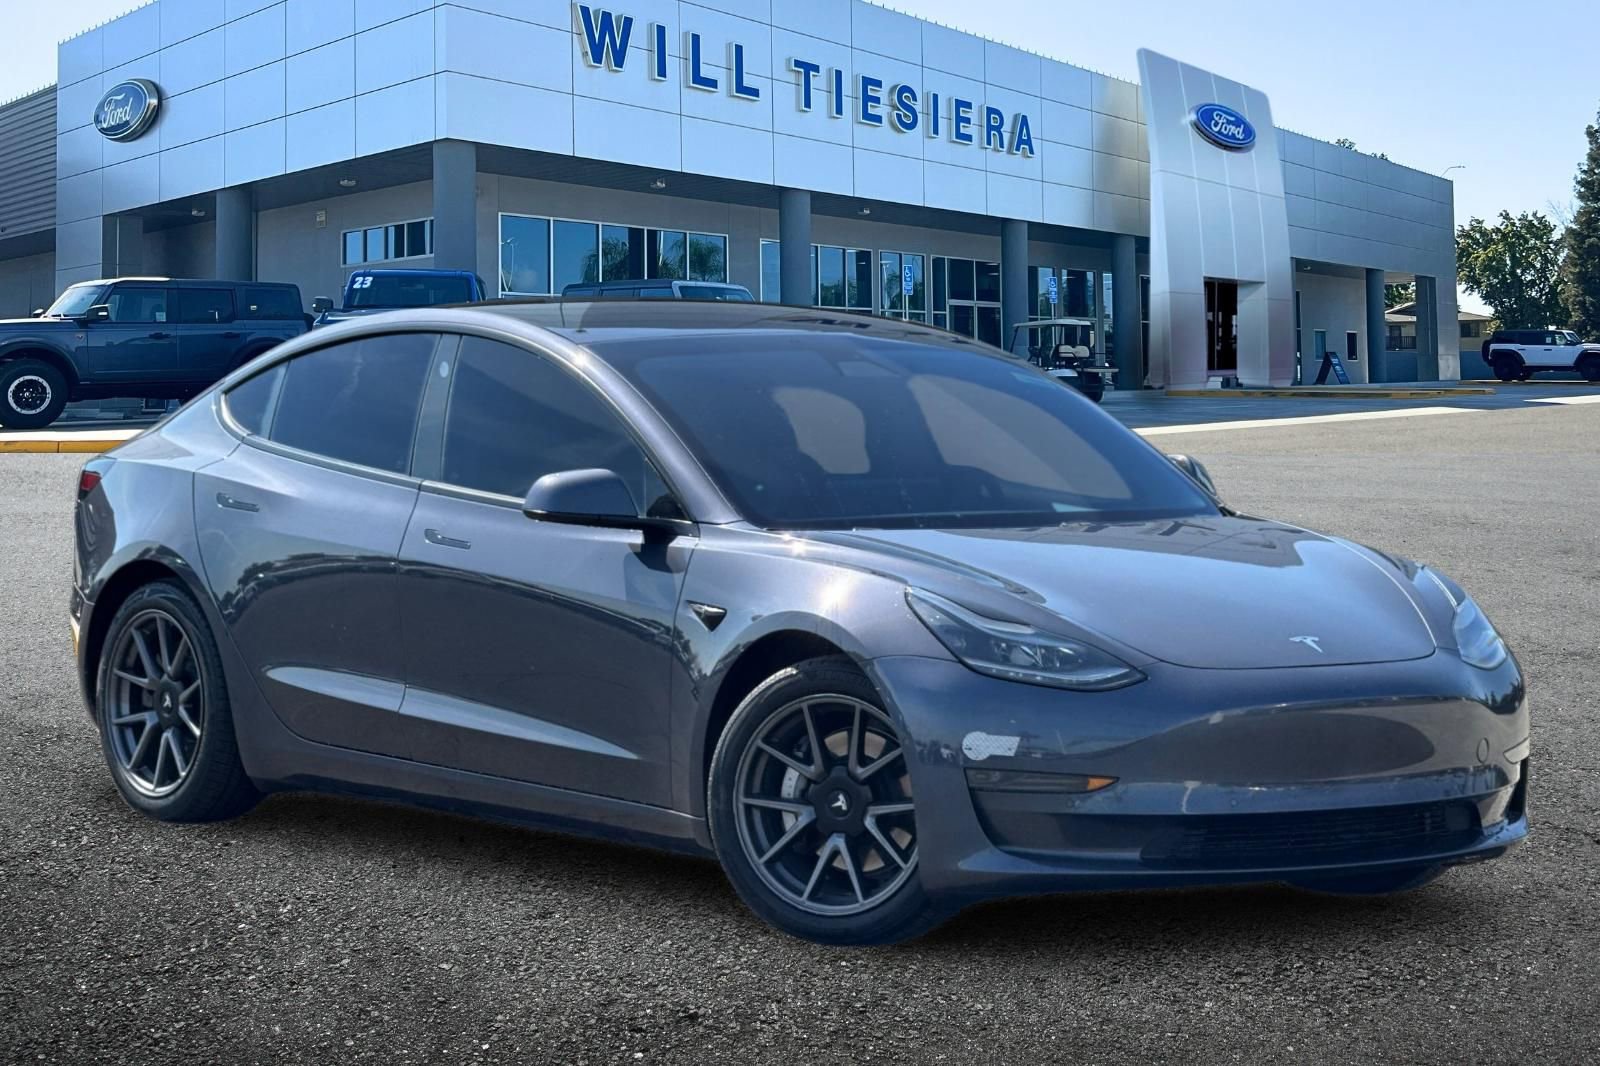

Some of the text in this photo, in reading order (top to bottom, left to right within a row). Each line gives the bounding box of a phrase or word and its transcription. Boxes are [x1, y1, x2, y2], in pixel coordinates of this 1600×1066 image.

[576, 3, 1036, 158] WILL TIESIERA
[102, 92, 134, 129] Ford
[1210, 110, 1245, 140] Ford
[352, 276, 374, 289] 23
